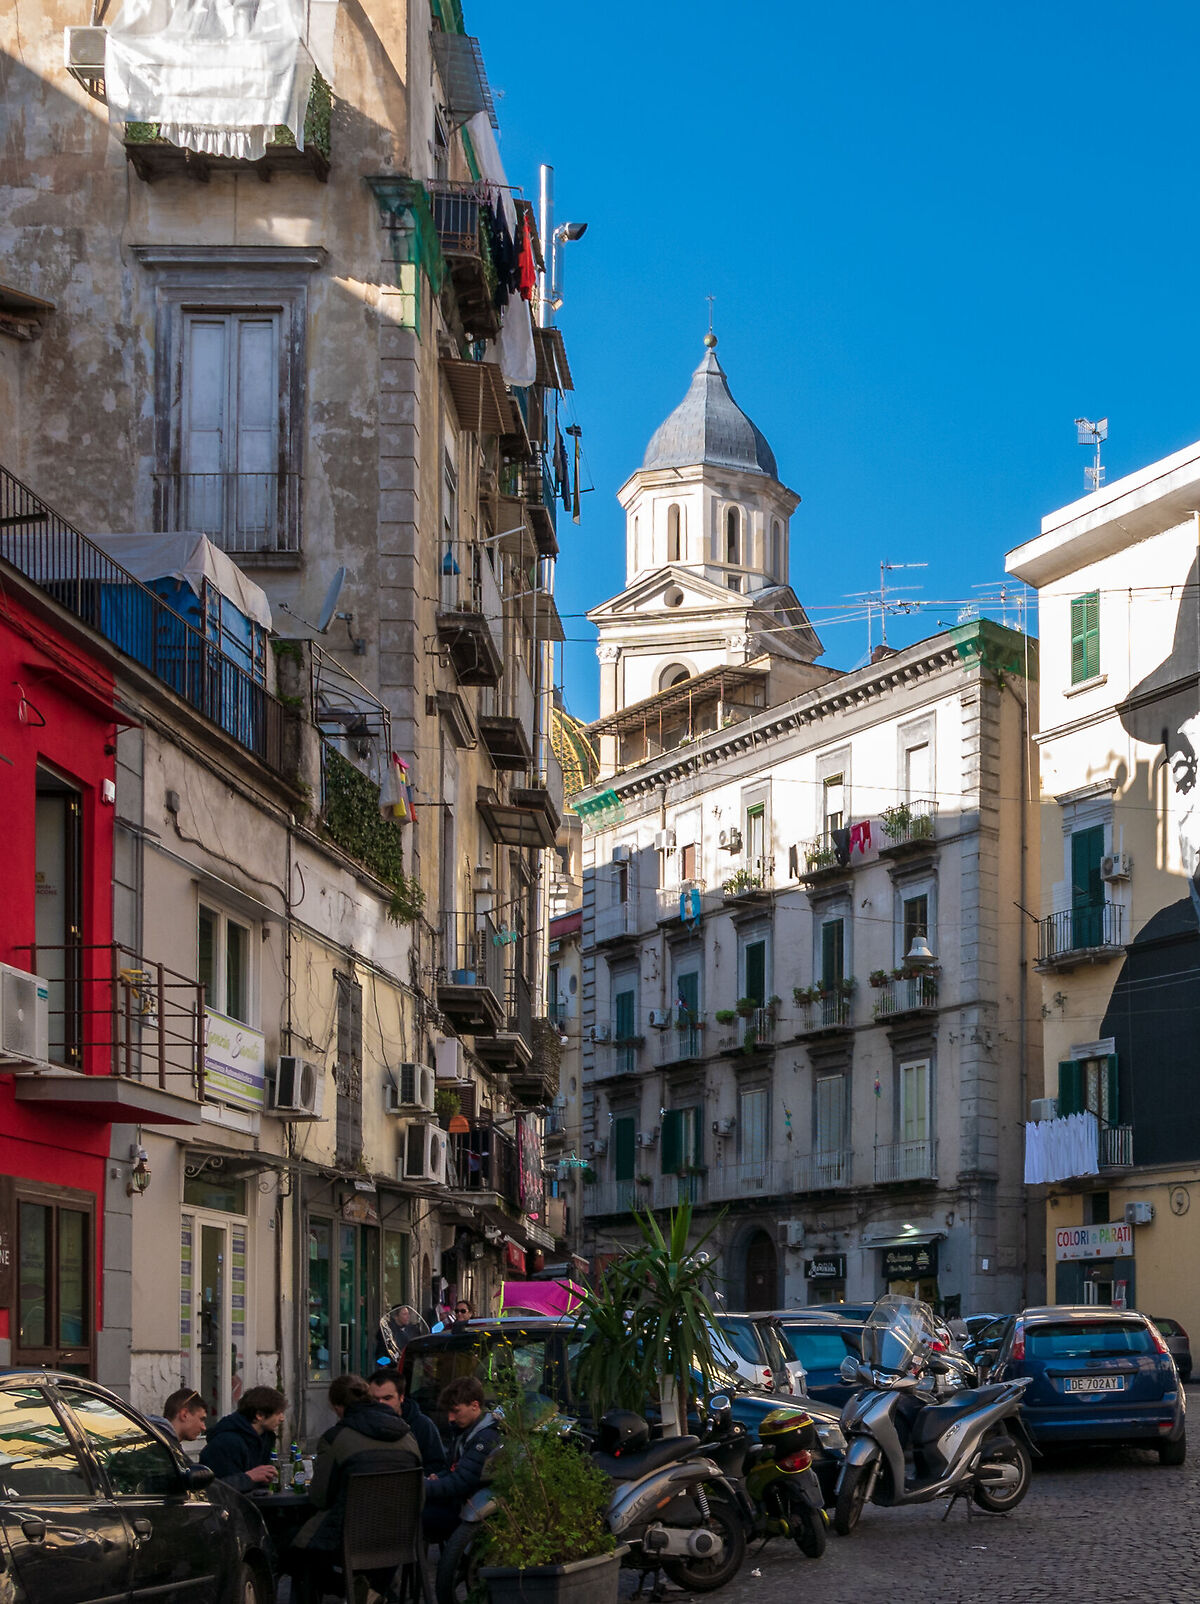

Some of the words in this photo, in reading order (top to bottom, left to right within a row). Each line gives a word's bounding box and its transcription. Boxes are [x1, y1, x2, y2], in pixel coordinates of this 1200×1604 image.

[1057, 1229, 1089, 1247] COLORI
[1100, 1225, 1131, 1244] PARATI
[1071, 1380, 1084, 1390] DE
[1087, 1378, 1117, 1389] 702AY
